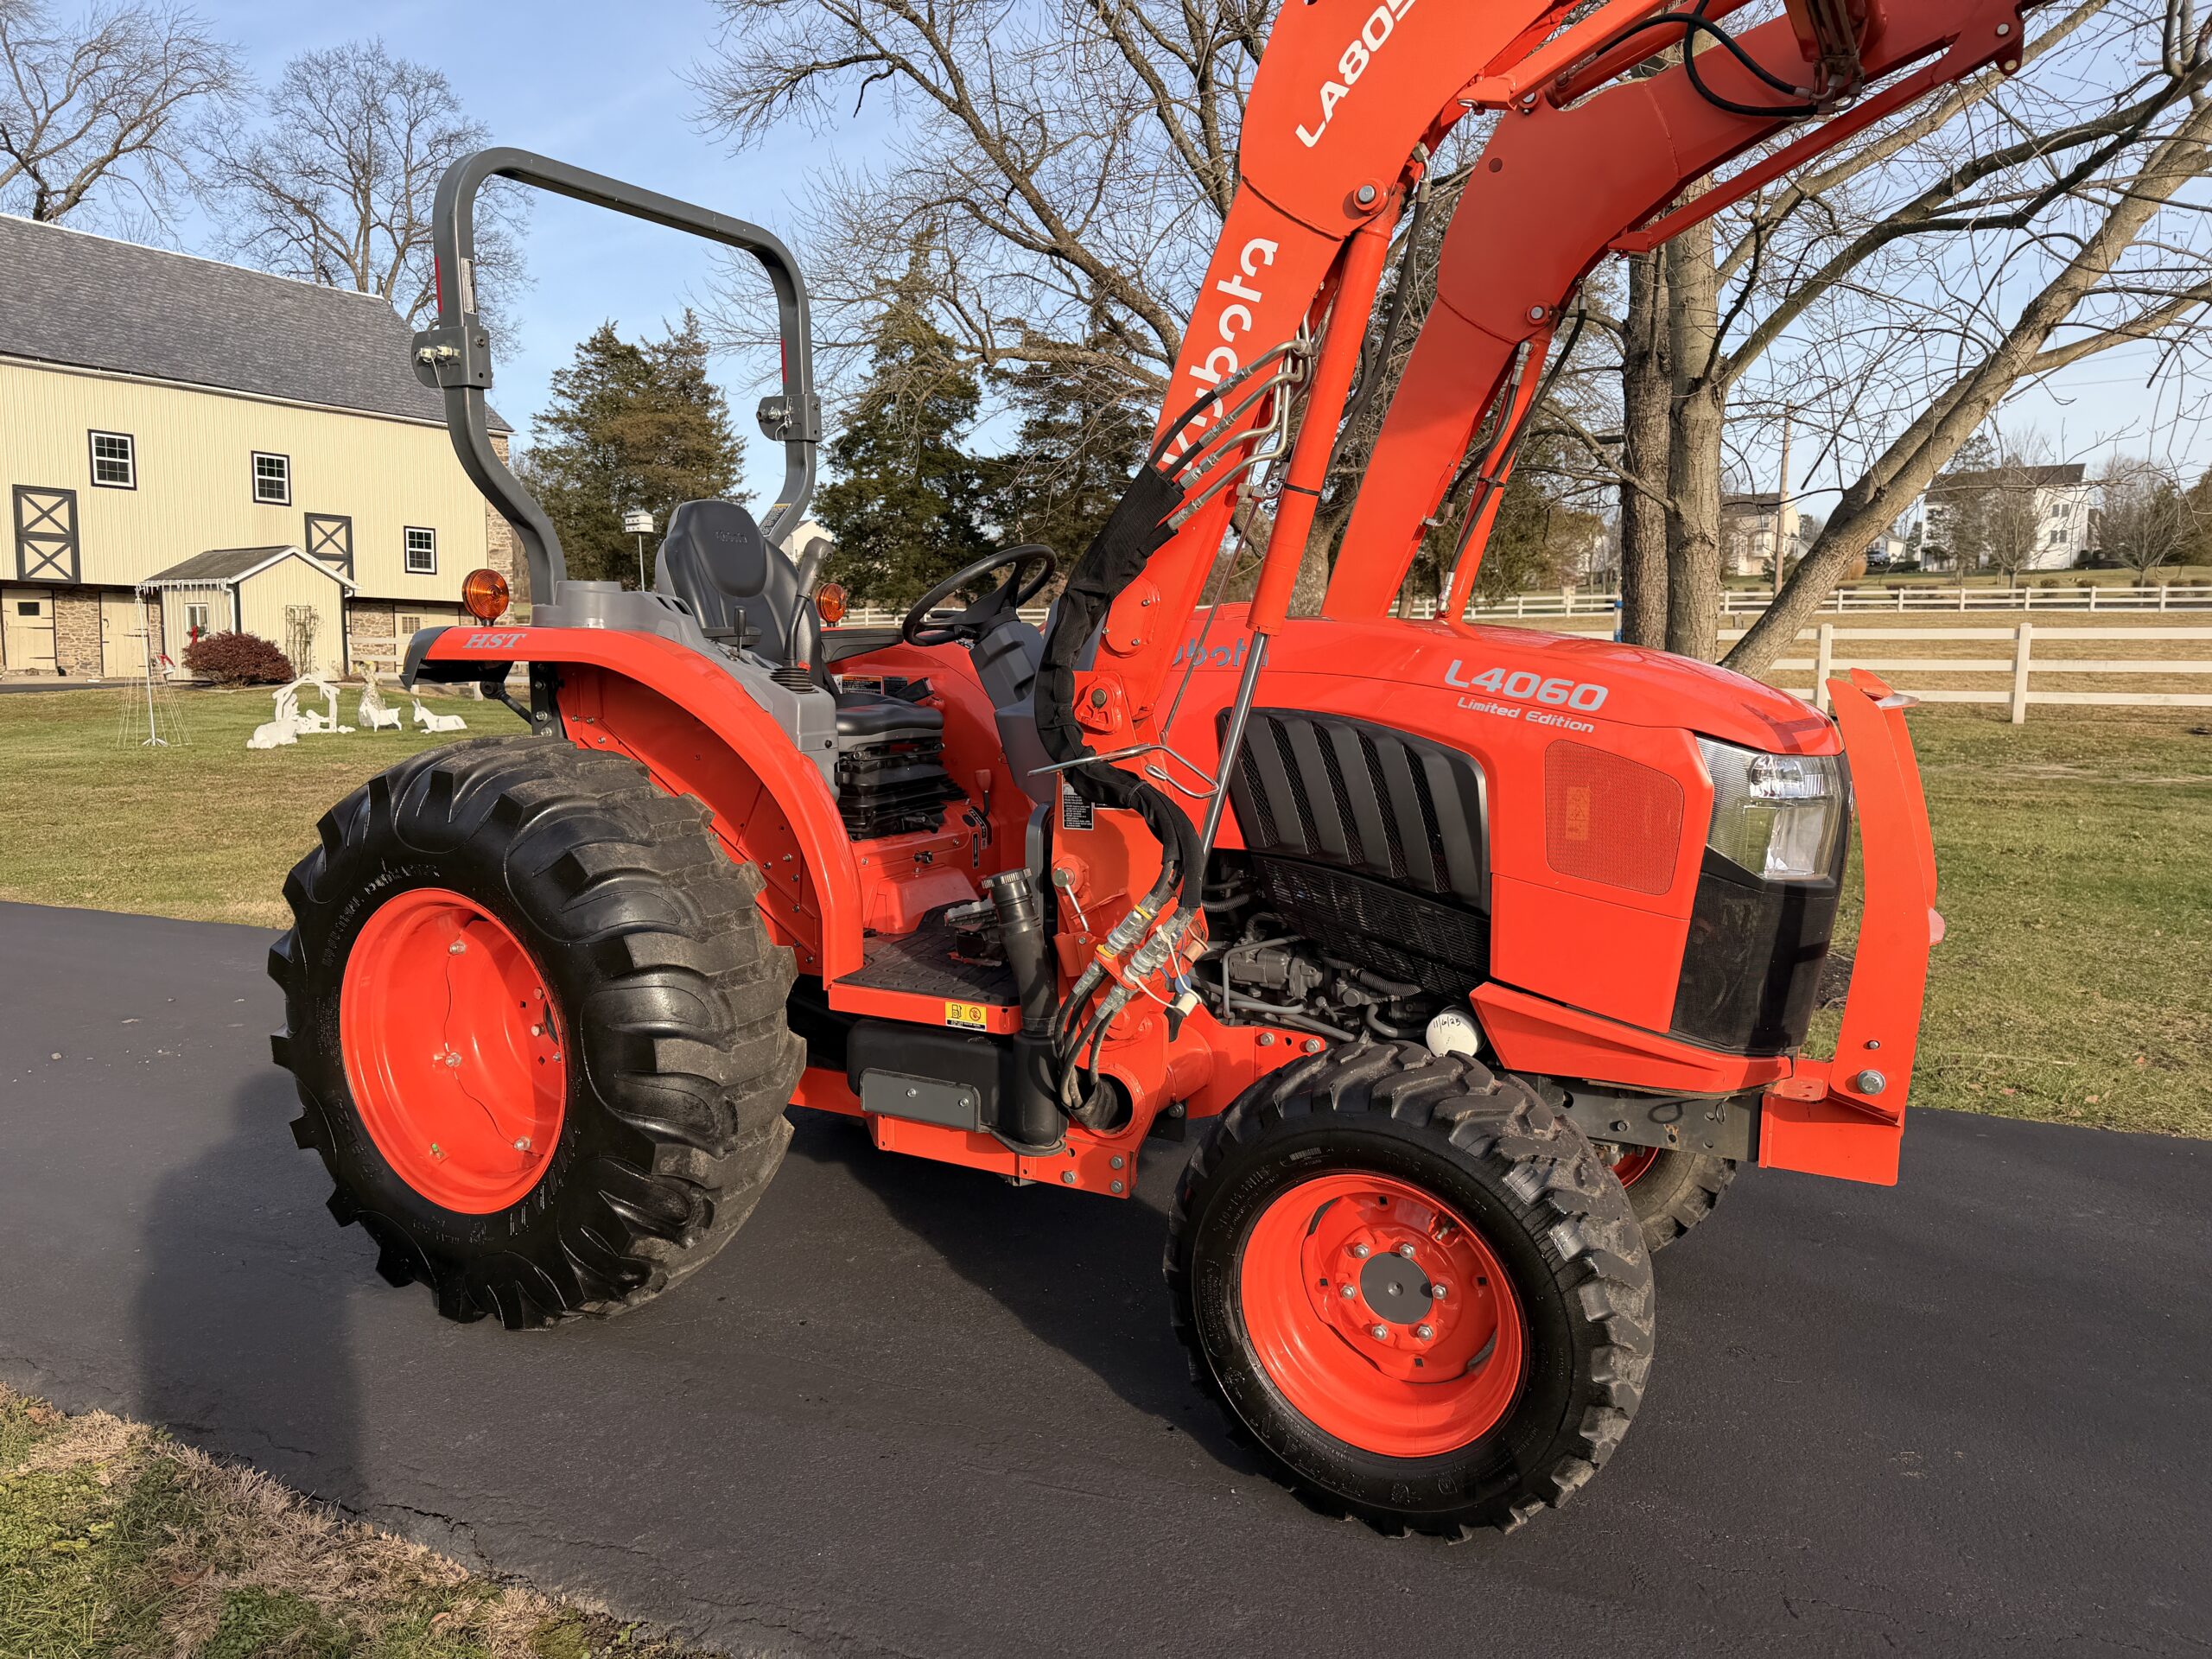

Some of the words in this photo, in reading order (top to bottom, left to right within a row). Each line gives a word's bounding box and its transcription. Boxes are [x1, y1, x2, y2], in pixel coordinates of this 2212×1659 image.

[462, 633, 527, 649] HST
[1444, 659, 1609, 711] L4060
[1457, 696, 1522, 719] Limited
[1525, 710, 1595, 734] Edition
